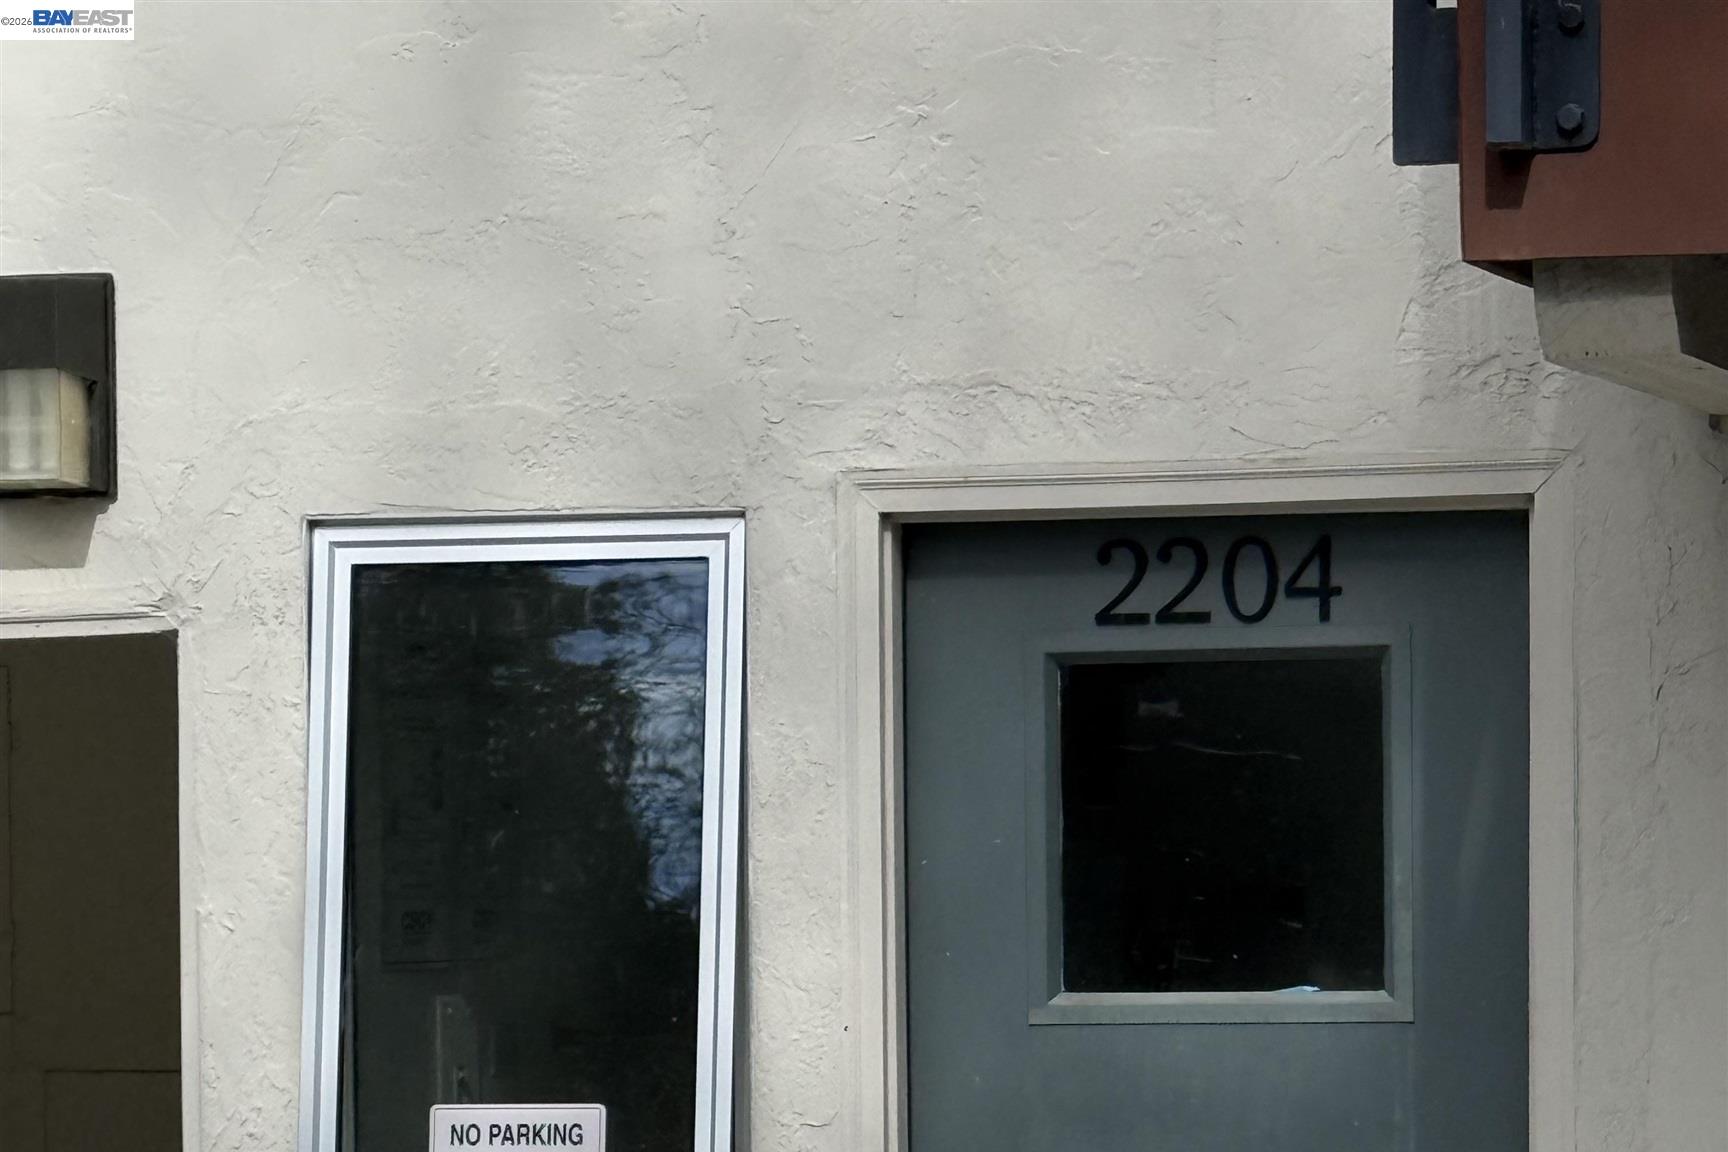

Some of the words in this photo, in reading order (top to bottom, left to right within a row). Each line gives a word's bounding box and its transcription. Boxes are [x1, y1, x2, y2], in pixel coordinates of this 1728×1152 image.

[1095, 533, 1343, 626] 2204
[450, 1123, 481, 1146] NO
[489, 1123, 584, 1146] PARKING
